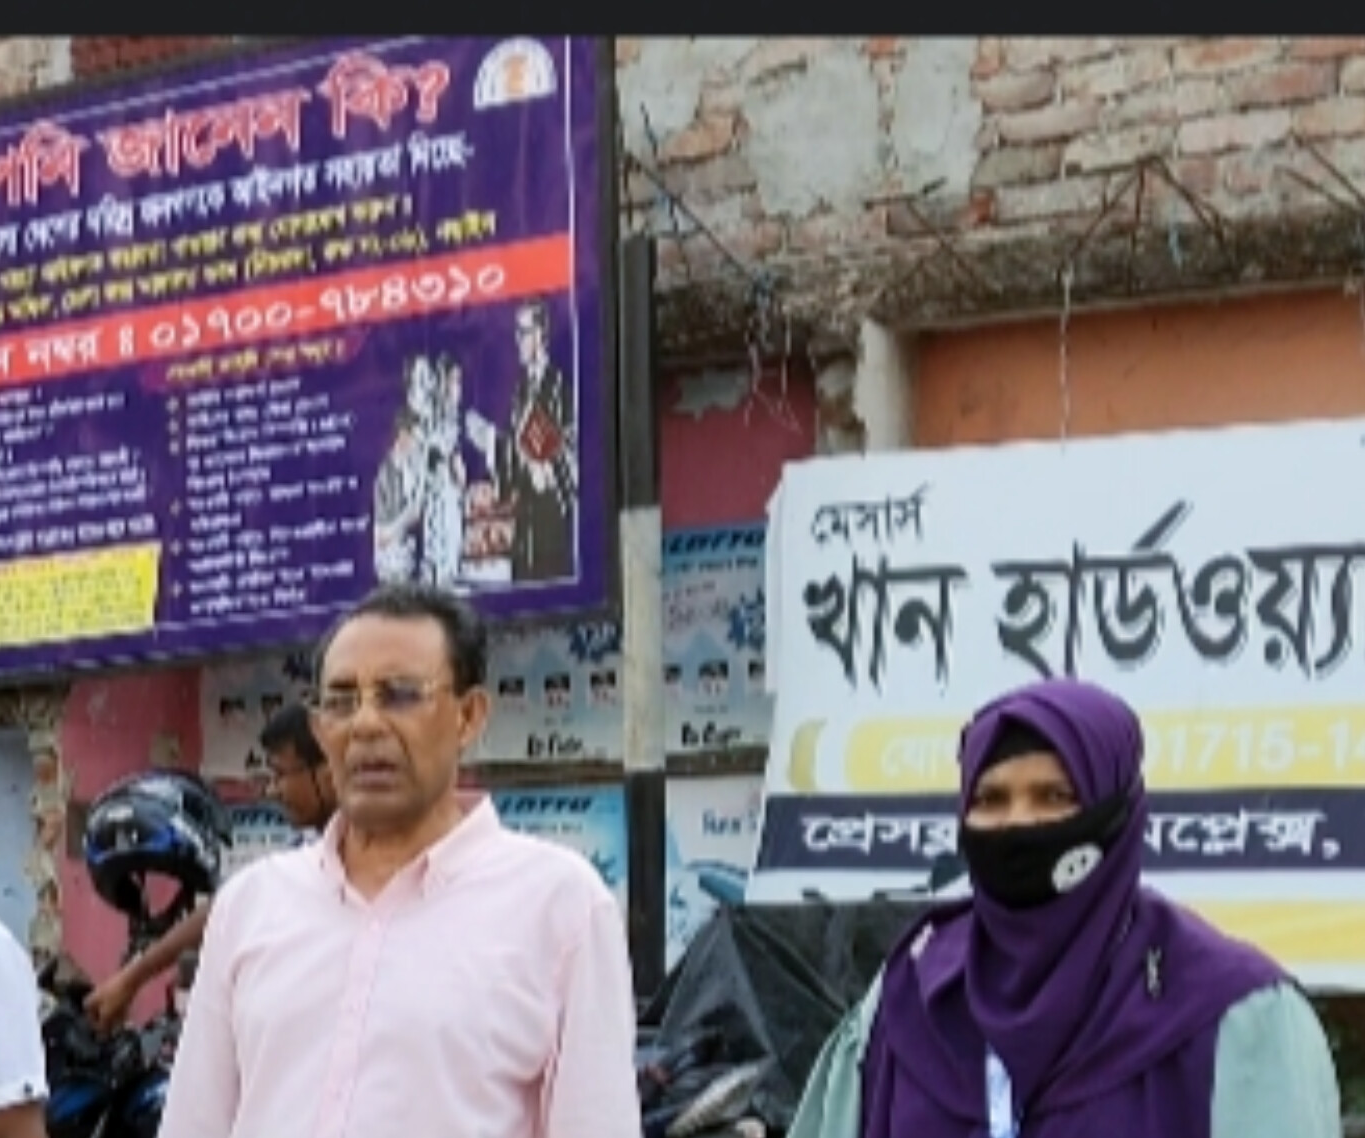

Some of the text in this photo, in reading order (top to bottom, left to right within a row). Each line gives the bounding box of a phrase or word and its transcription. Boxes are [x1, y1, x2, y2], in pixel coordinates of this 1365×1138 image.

[95, 86, 312, 178] জানেন
[316, 50, 450, 140] কি?
[24, 327, 102, 374] নম্বর
[149, 264, 506, 349] ০১৭০০-৭৮৪৩১০
[811, 482, 933, 546] মেসার্স
[803, 553, 969, 696] খান
